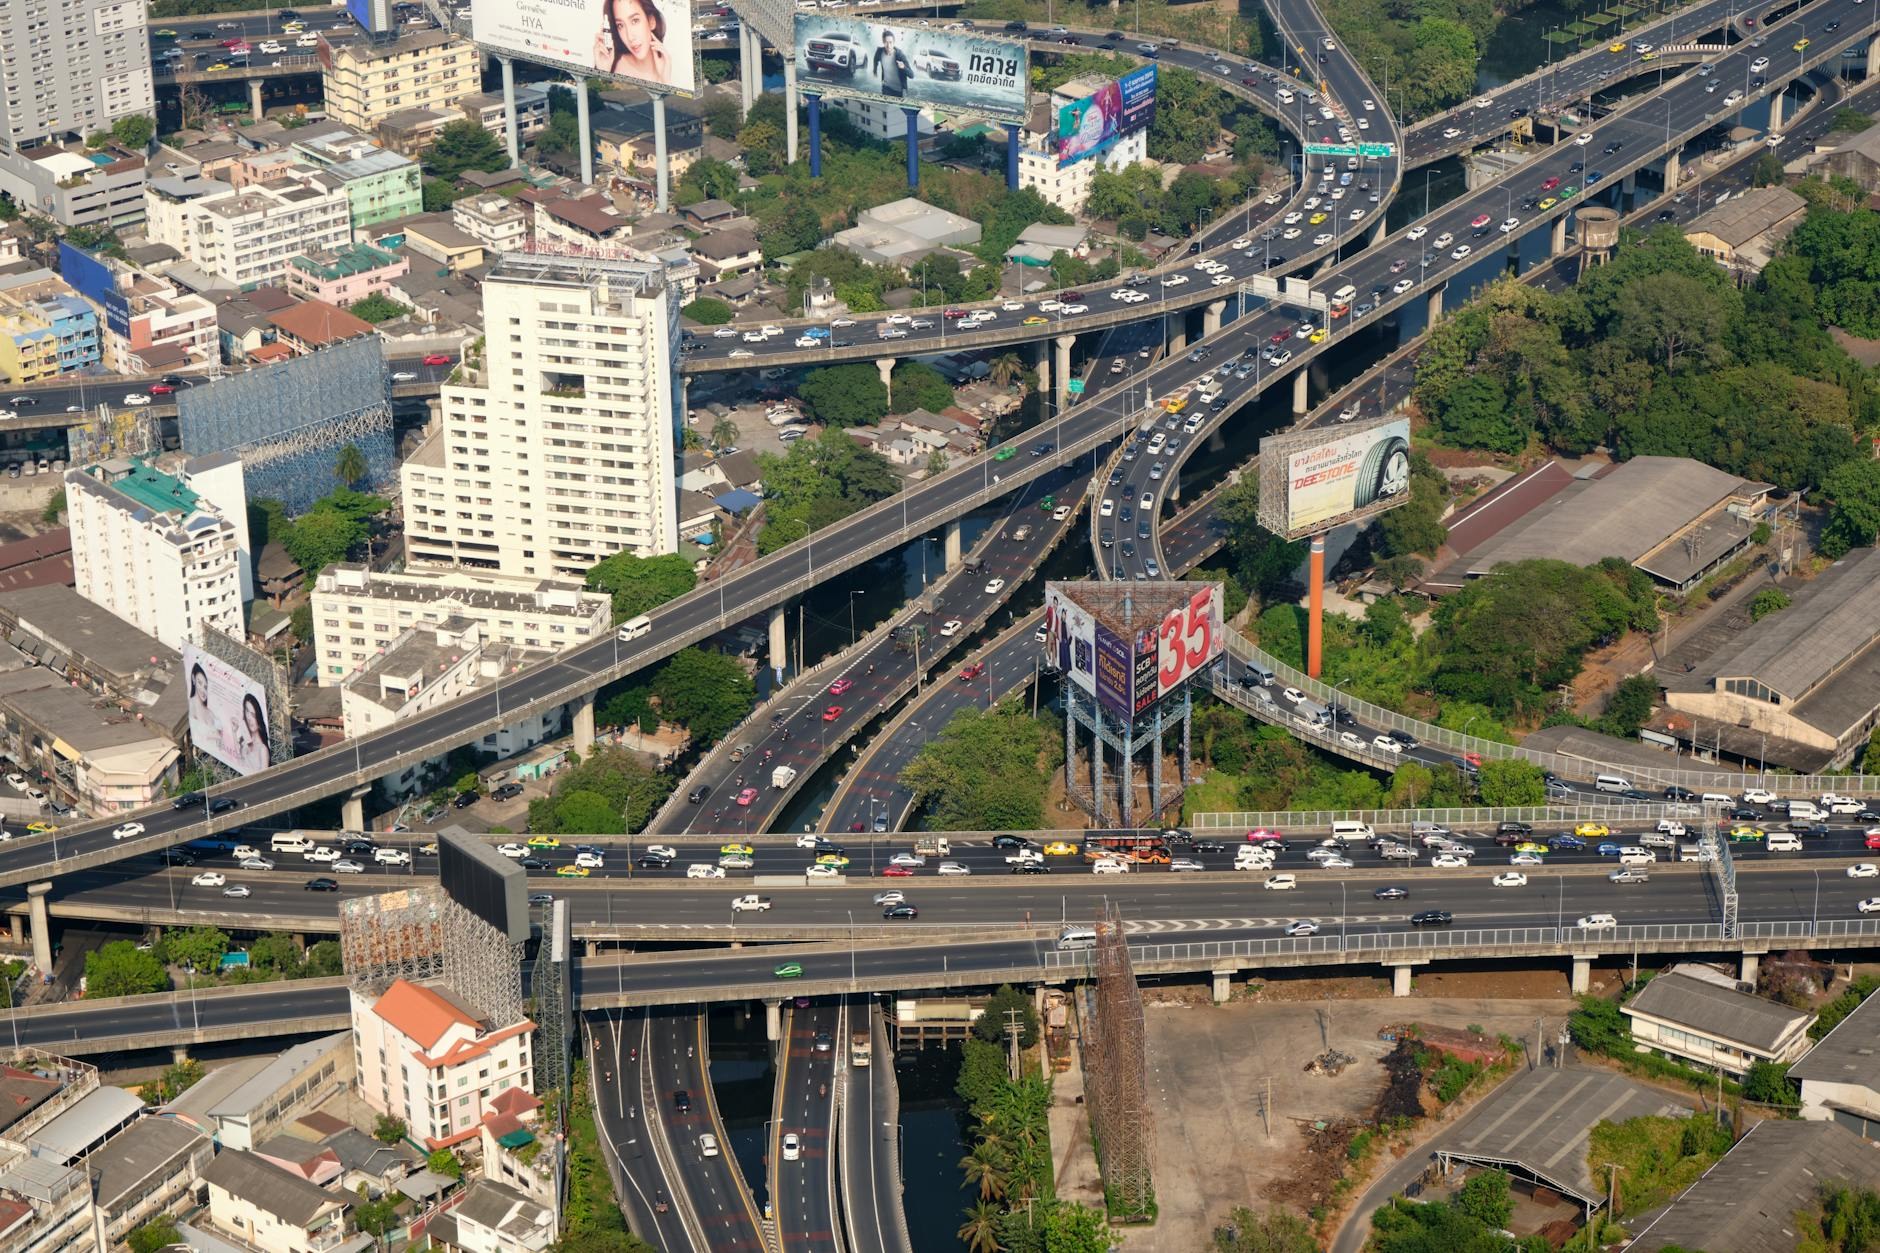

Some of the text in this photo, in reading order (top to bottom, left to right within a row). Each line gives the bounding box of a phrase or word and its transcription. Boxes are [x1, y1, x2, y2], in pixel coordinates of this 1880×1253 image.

[521, 15, 543, 30] HYA
[969, 53, 1018, 77] ทลาย
[1159, 585, 1212, 688] 35
[1136, 657, 1151, 674] SCB
[1135, 691, 1157, 712] SALE
